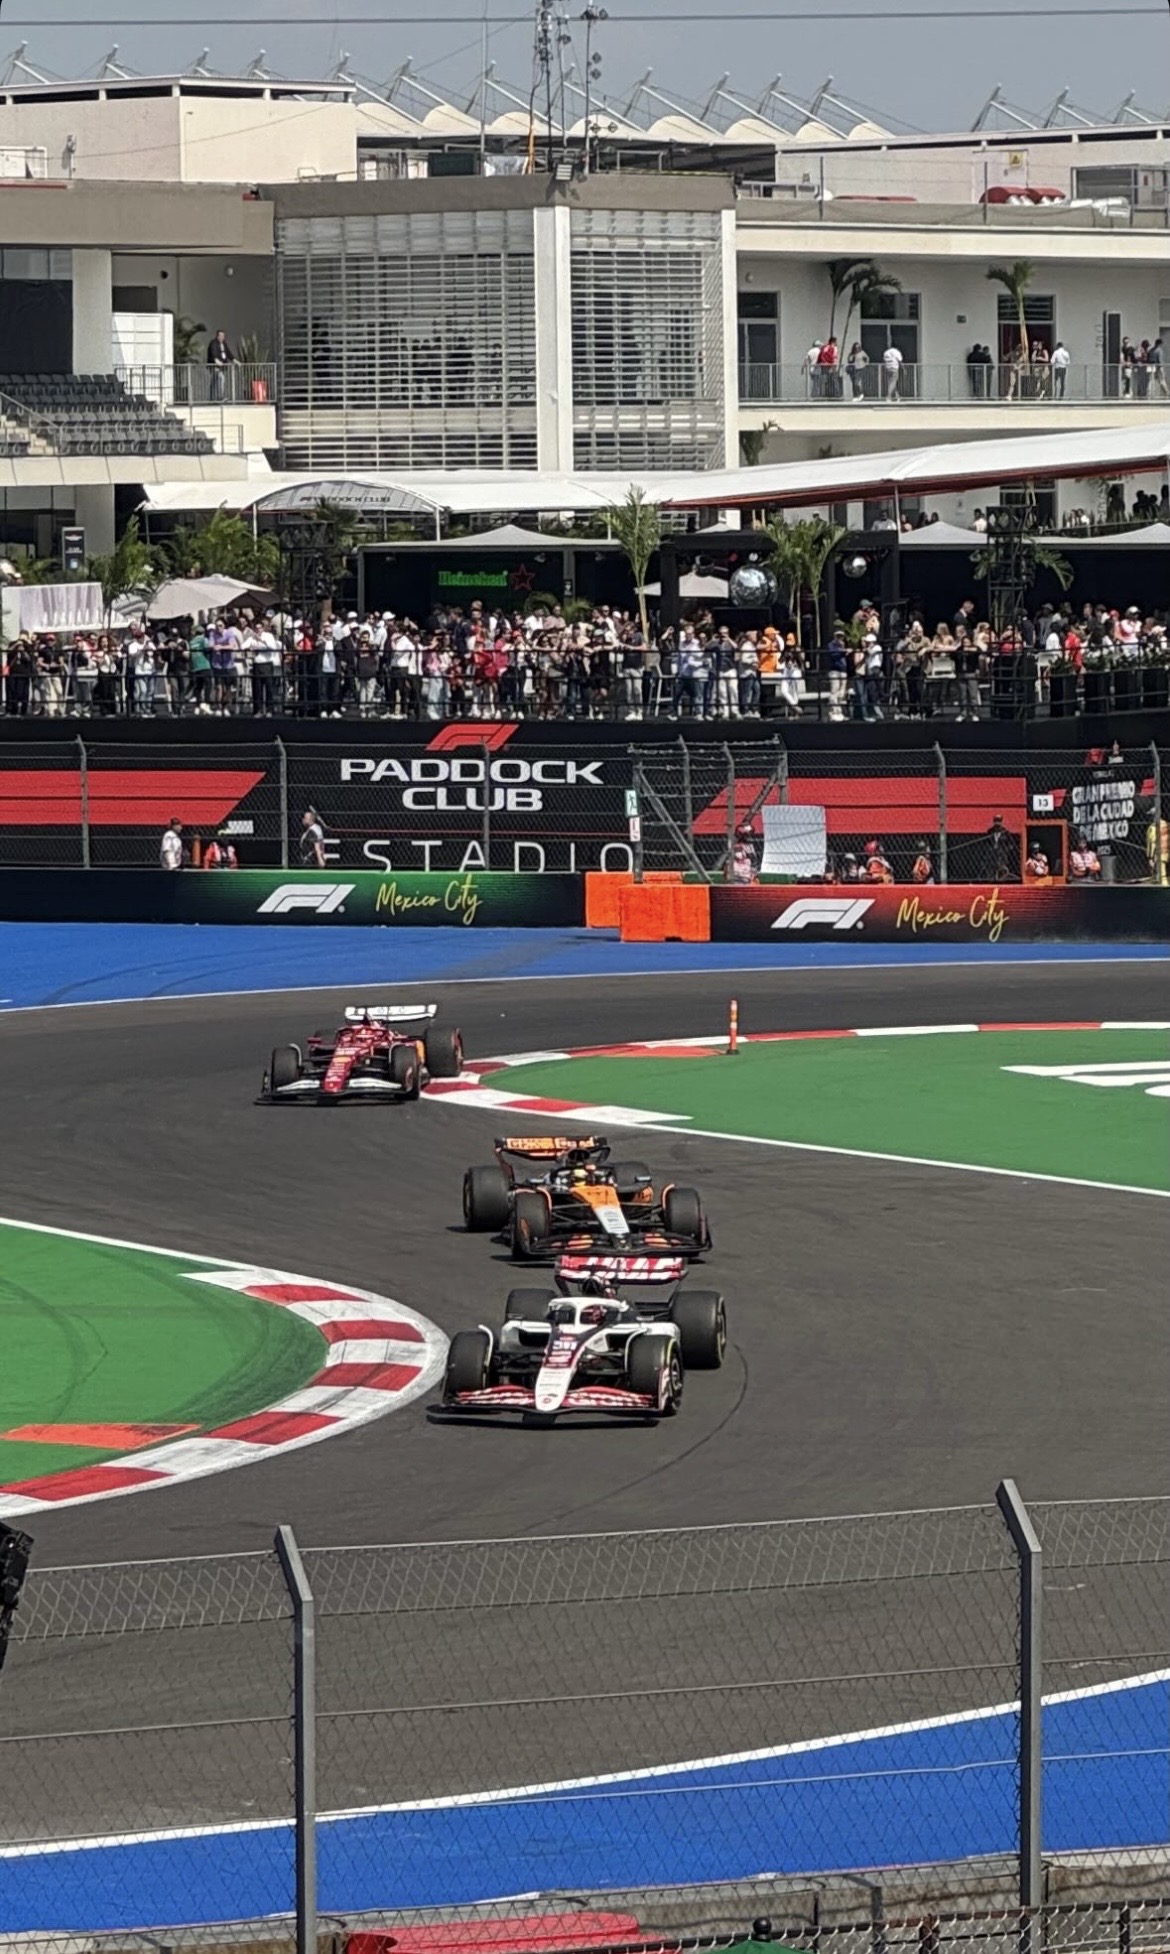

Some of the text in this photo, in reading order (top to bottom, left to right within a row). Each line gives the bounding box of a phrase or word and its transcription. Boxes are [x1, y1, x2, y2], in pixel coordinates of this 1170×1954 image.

[340, 758, 605, 785] PADDOCK
[402, 787, 543, 812] CLUB
[375, 872, 484, 926] Mexico City
[896, 886, 1010, 943] Mexico City
